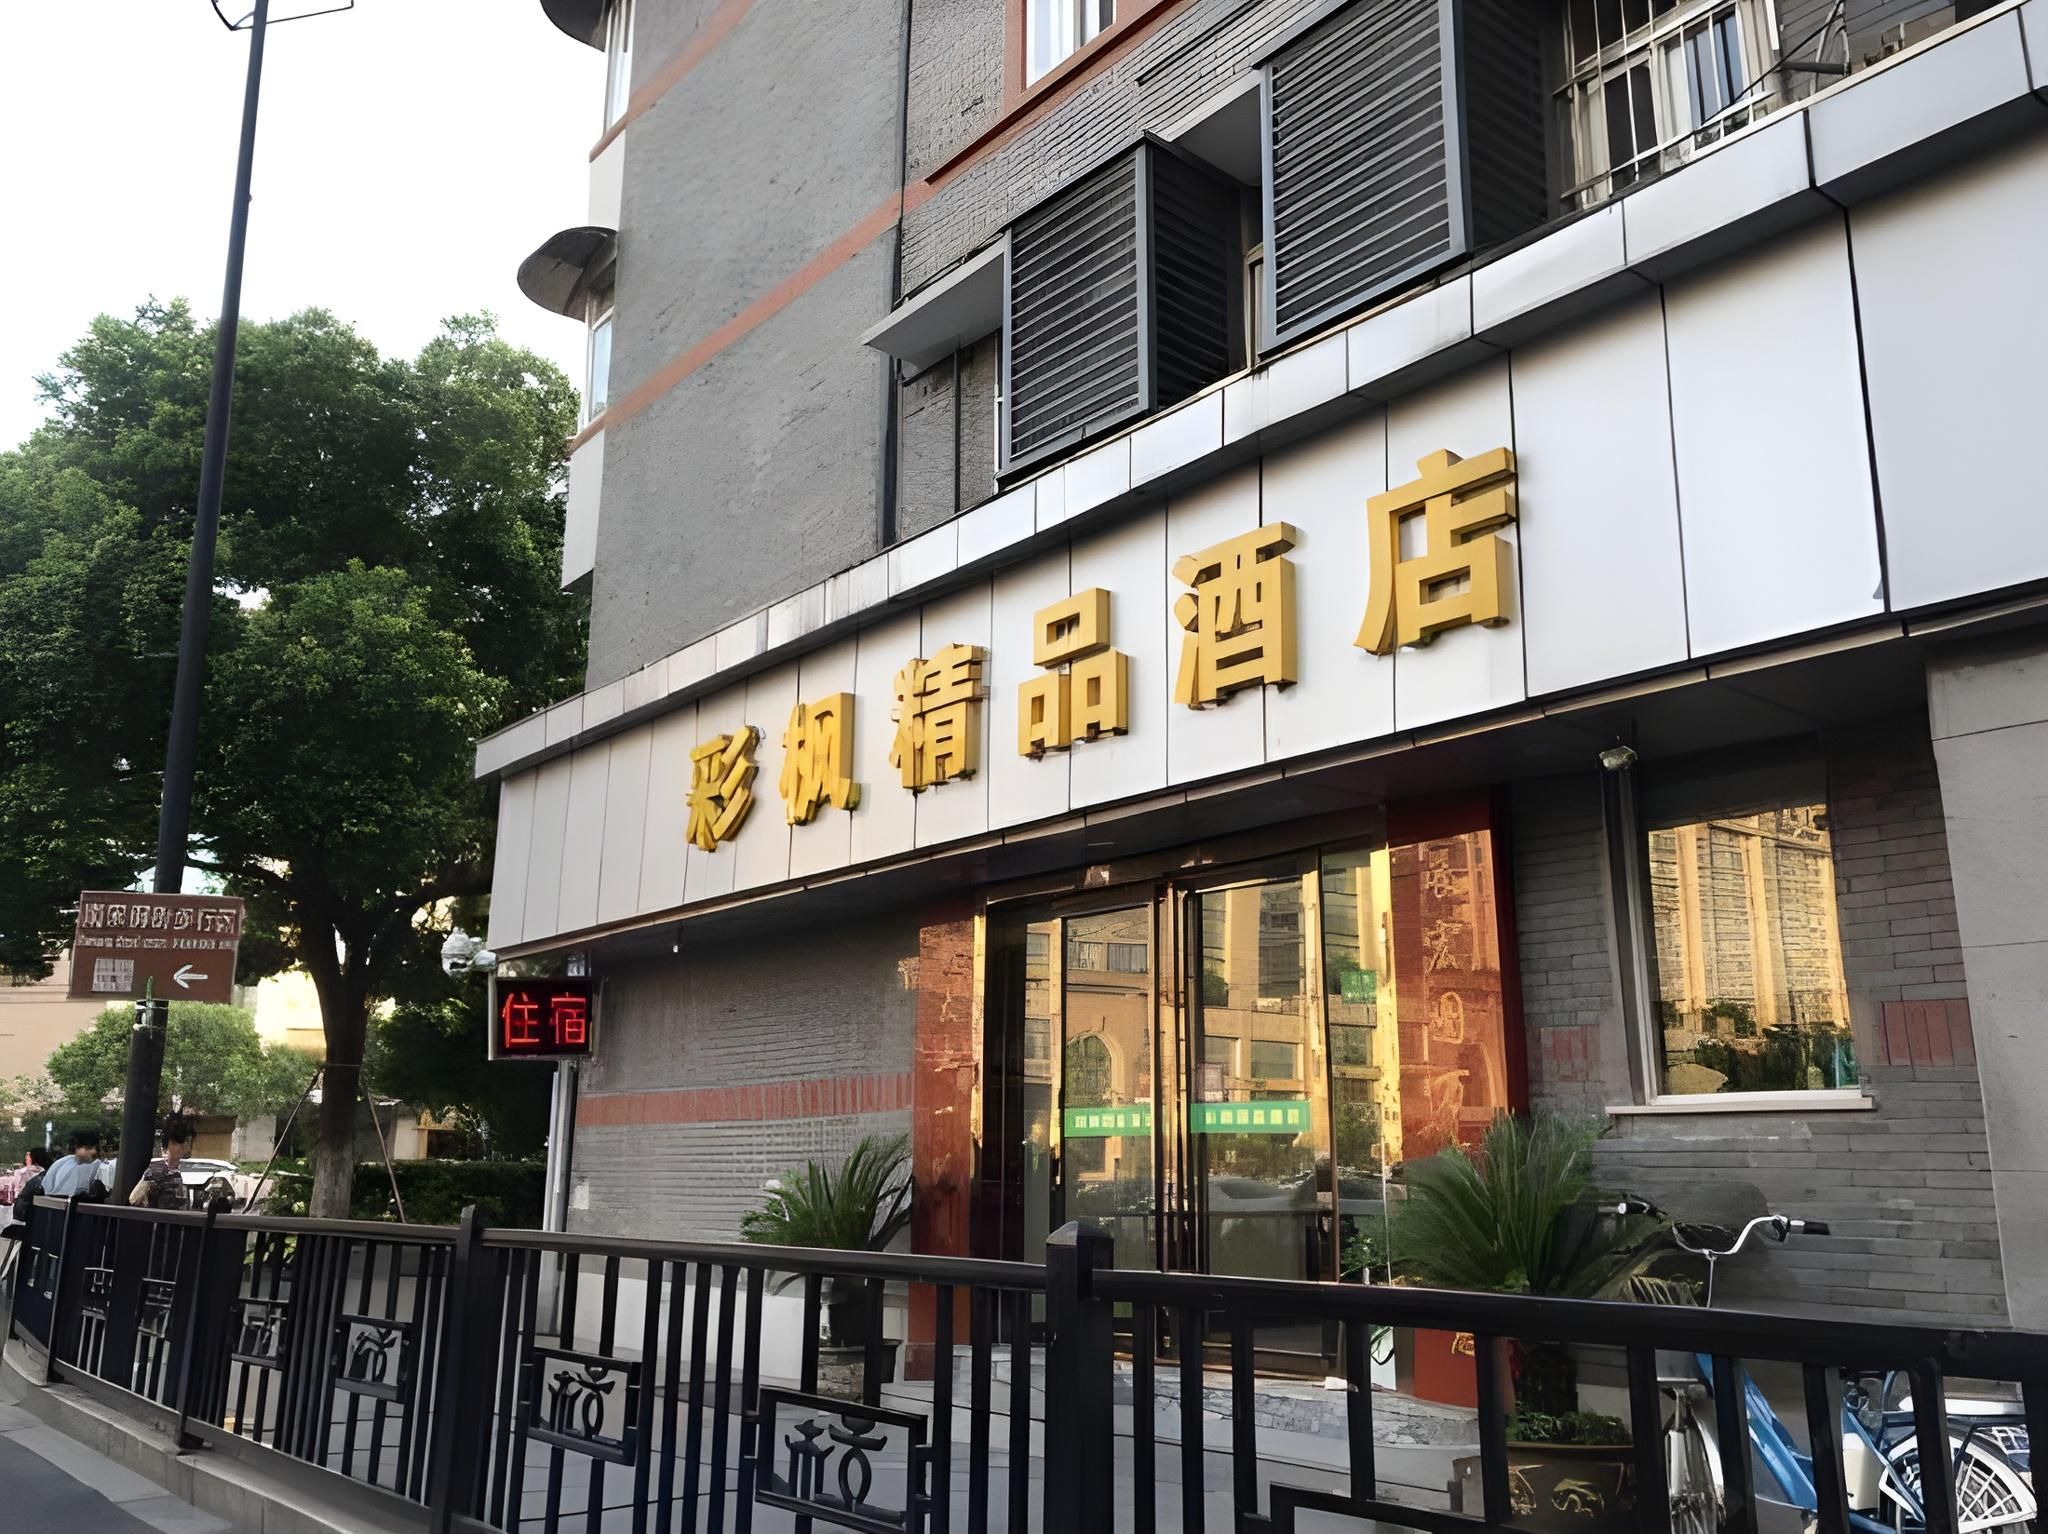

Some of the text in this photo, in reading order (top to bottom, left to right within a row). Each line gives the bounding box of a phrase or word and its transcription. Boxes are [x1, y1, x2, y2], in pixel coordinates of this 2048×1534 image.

[685, 447, 1517, 853] 彩枫精品酒店
[502, 991, 587, 1048] 住宿
